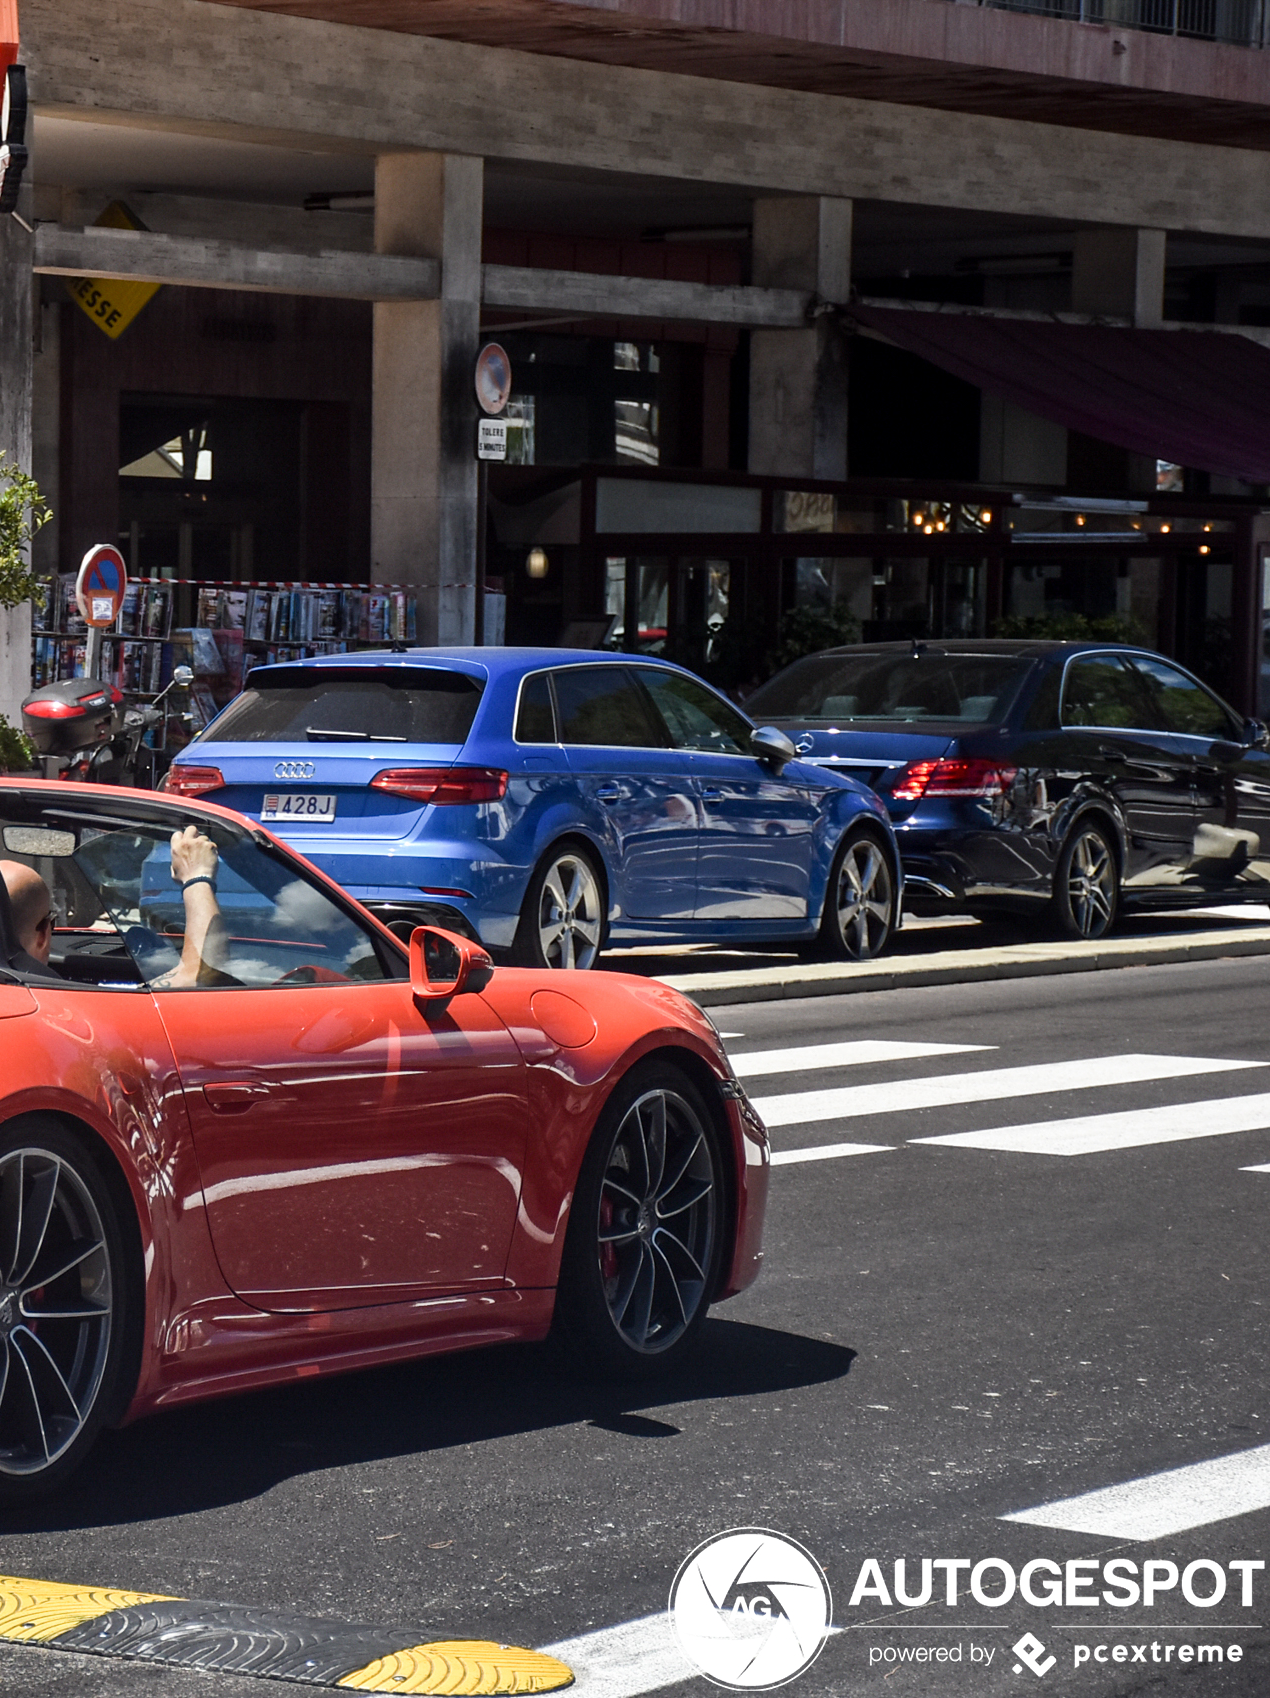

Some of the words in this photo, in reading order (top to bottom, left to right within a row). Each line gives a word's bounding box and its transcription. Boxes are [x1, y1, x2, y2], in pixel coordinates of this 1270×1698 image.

[72, 279, 123, 329] ESSE
[483, 443, 505, 453] MINUTES
[282, 796, 332, 815] 428J
